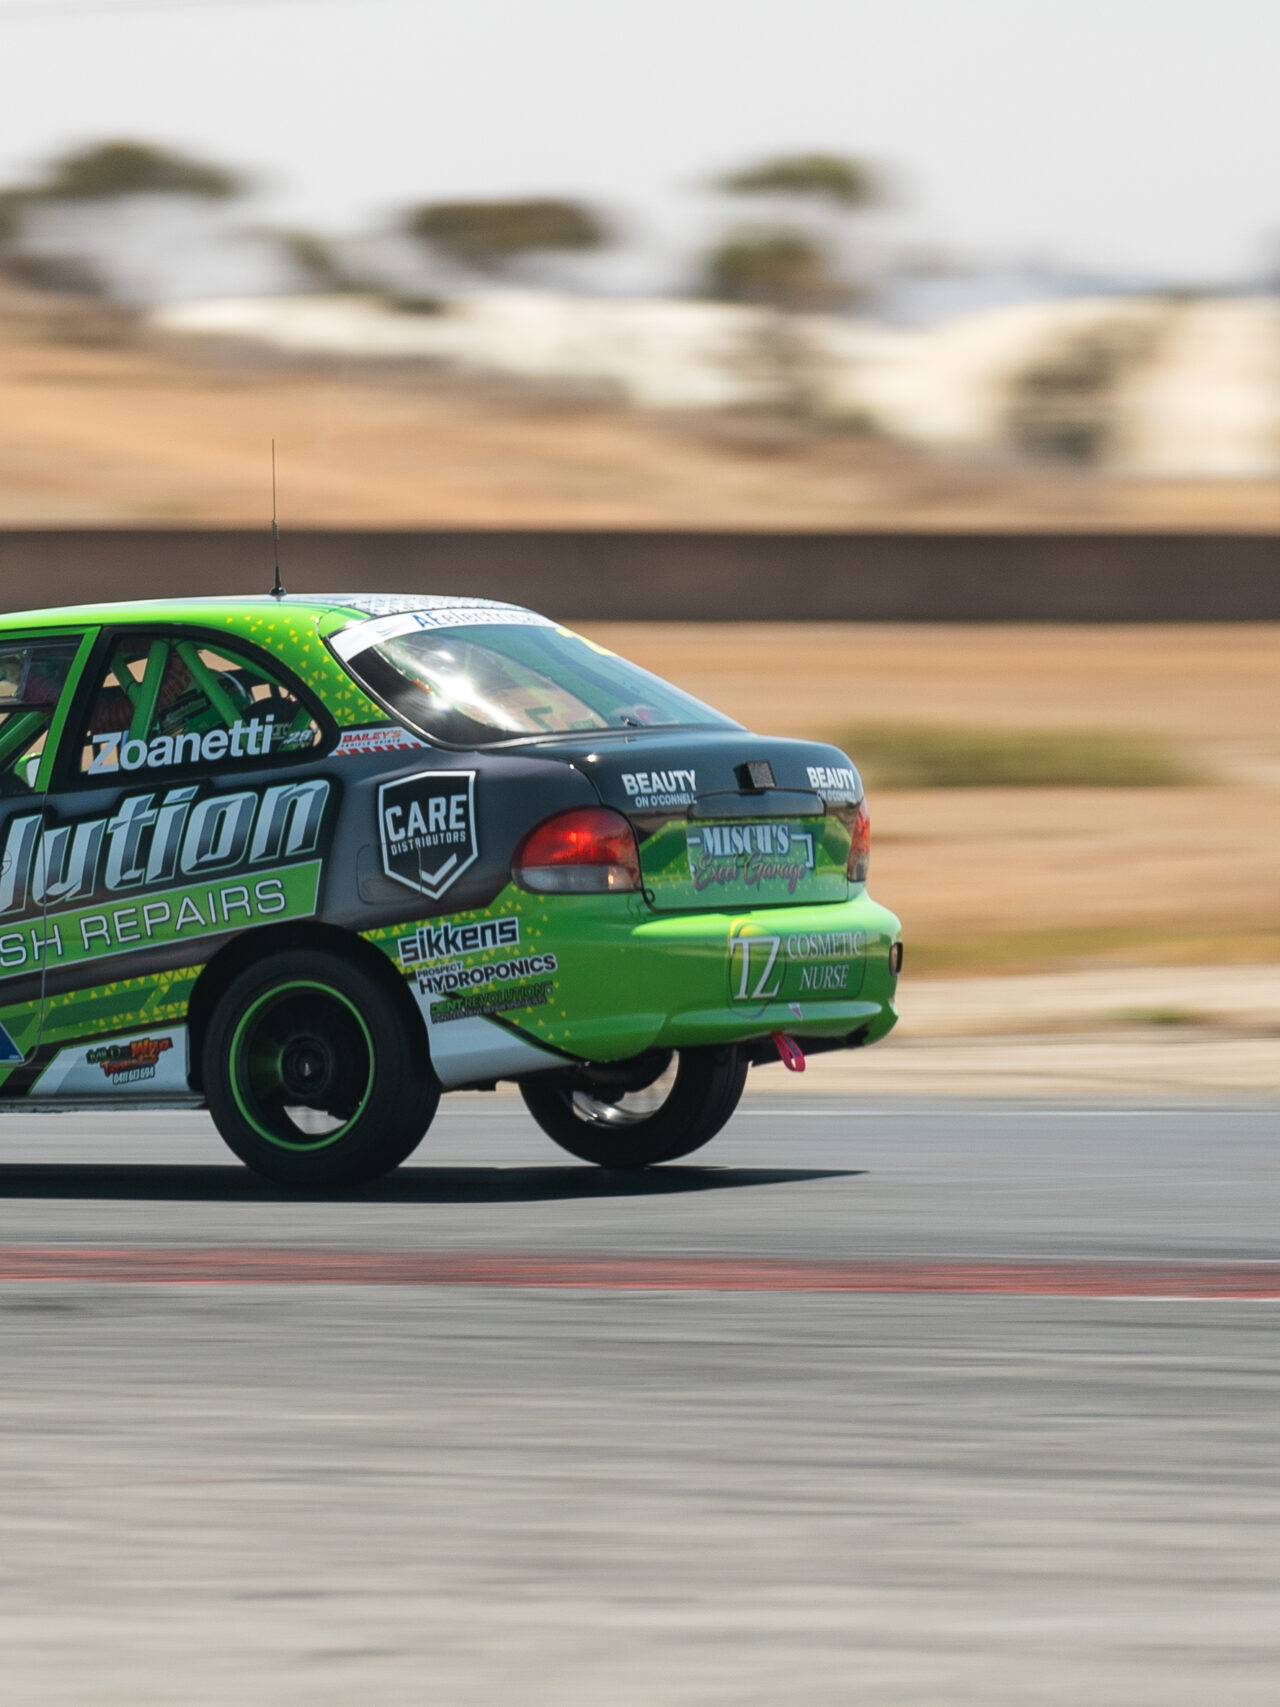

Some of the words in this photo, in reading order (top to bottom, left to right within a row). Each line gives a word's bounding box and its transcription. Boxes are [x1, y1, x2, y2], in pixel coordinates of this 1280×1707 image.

[88, 714, 274, 775] Zoanetti
[342, 728, 402, 744] BAILEY'S
[622, 770, 697, 795] BEAUTY
[806, 767, 856, 791] BEAUTY
[635, 795, 649, 808] ON
[650, 793, 698, 807] O'CONNELL
[385, 794, 467, 842] CARE
[390, 831, 467, 856] DISTRIBUTORS
[702, 823, 790, 857] MISCH'S
[742, 850, 806, 894] Garage
[79, 878, 287, 950] REPAIRS
[787, 931, 863, 959] COSMETIC
[418, 962, 463, 978] PROSPECT
[420, 954, 556, 994] HYDROPONICS
[729, 936, 781, 1000] TZ
[800, 964, 849, 991] NURSE
